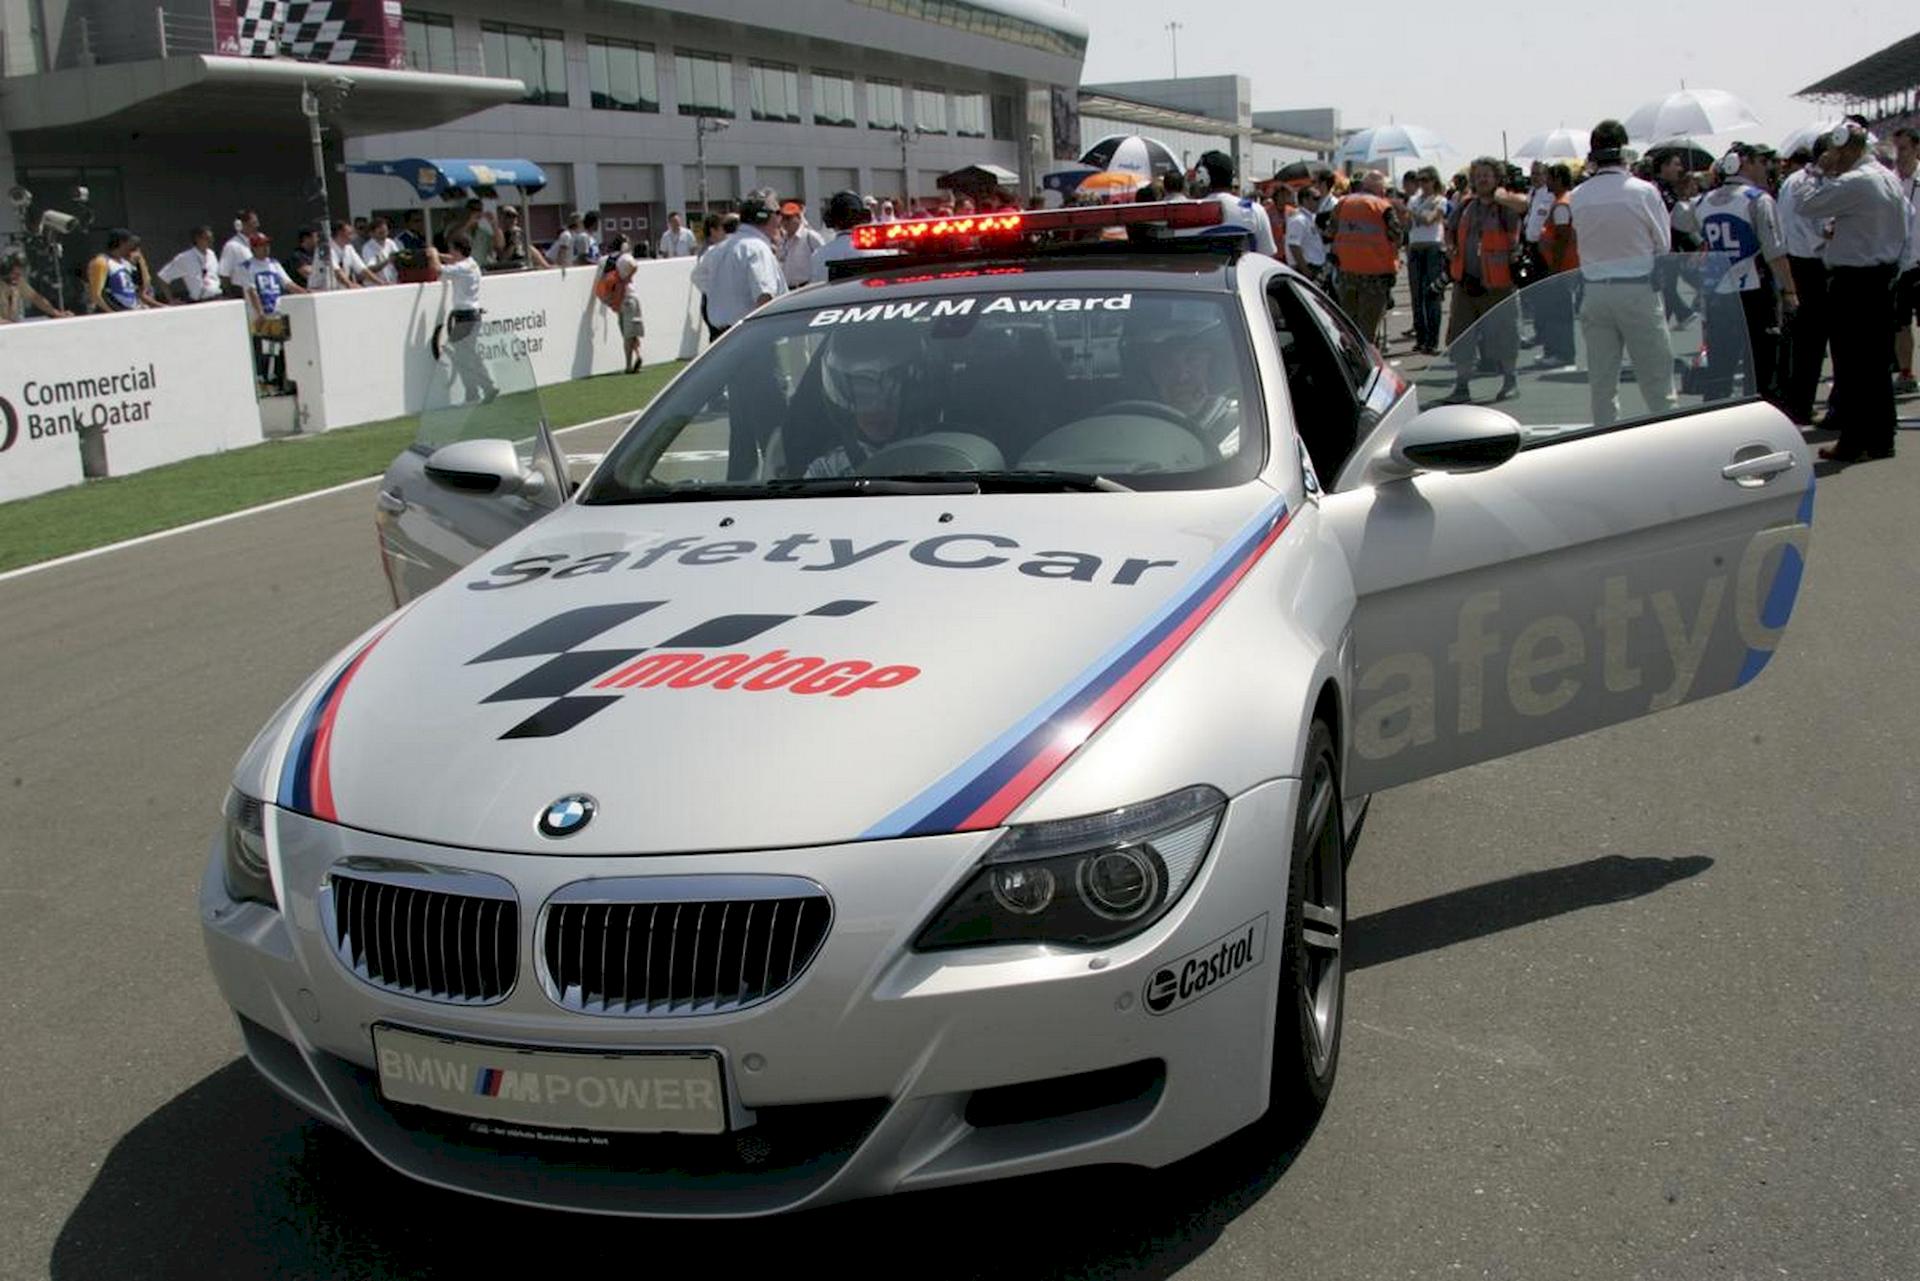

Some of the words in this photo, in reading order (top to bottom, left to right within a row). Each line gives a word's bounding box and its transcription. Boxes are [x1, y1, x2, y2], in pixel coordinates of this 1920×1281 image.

[1705, 222, 1741, 250] PL
[480, 308, 547, 337] ommercial
[808, 301, 930, 327] BMW
[931, 298, 977, 317] M
[981, 293, 1134, 315] Award
[23, 363, 156, 407] Commercial
[28, 406, 84, 440] Bank
[91, 400, 152, 434] Qatar
[1180, 926, 1254, 999] Castrol
[380, 1048, 468, 1095] BMW
